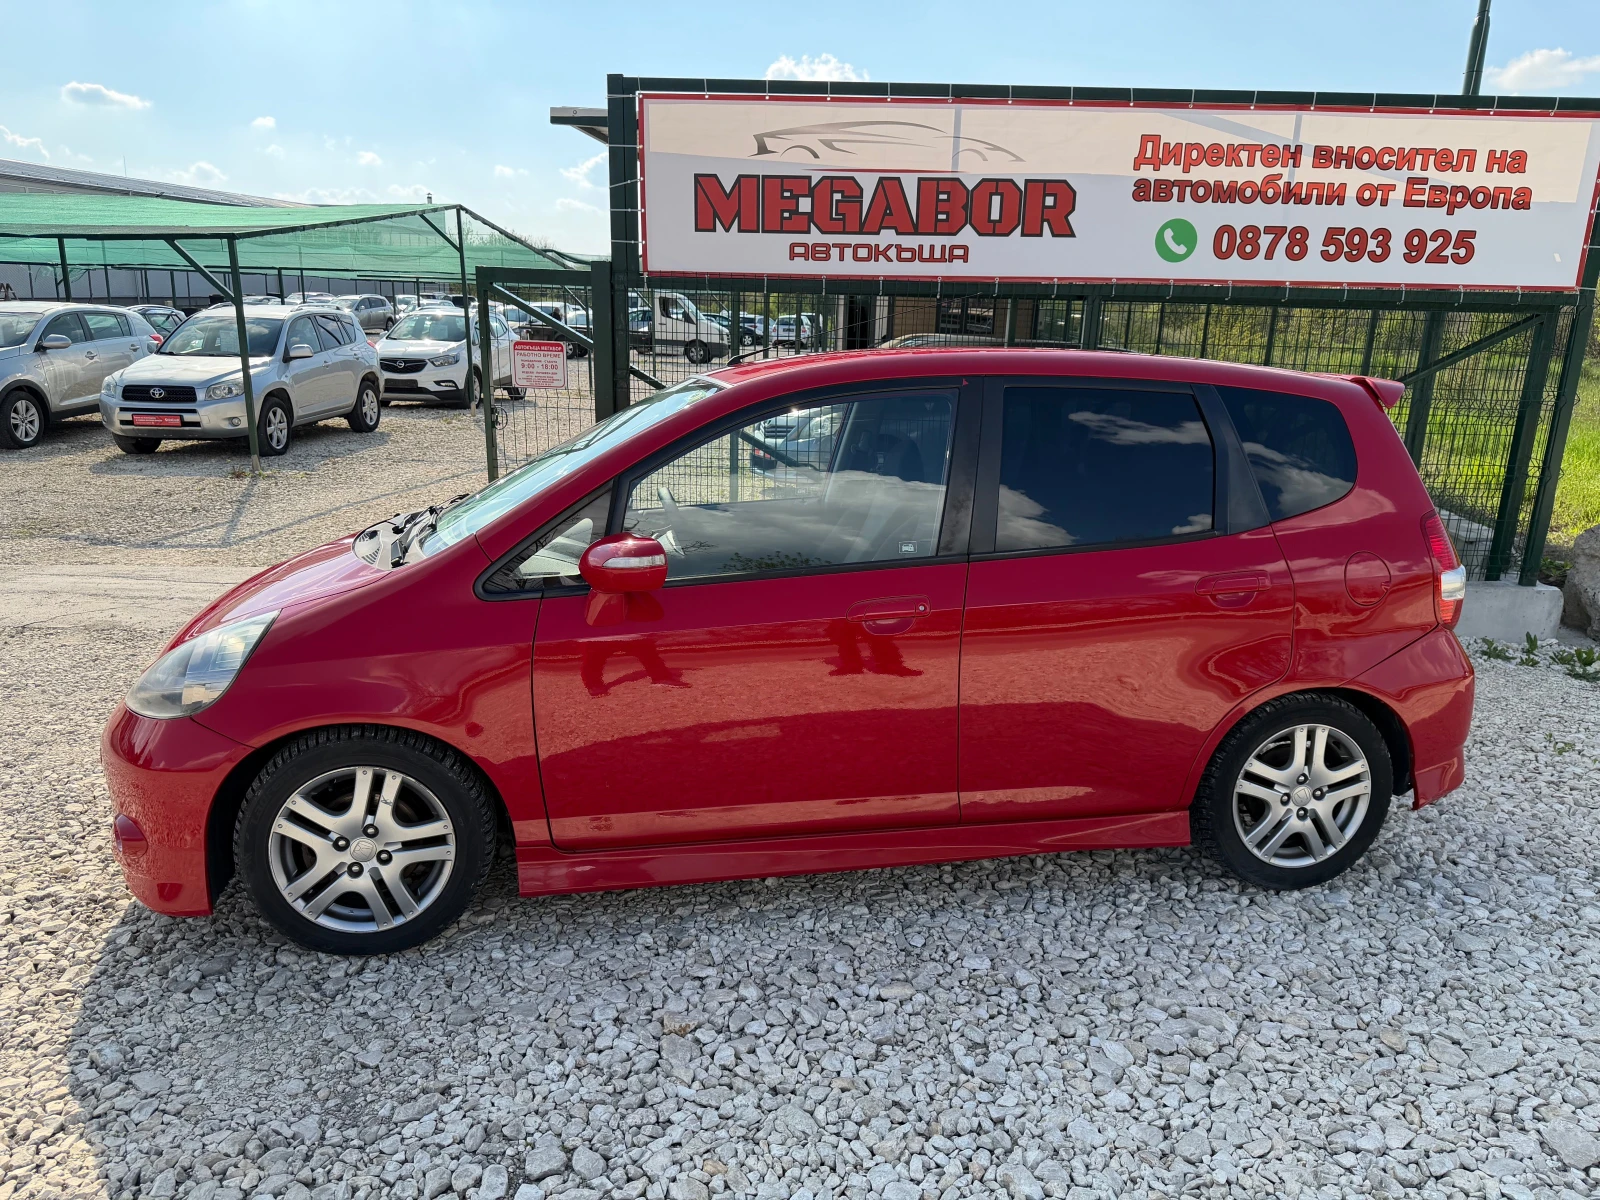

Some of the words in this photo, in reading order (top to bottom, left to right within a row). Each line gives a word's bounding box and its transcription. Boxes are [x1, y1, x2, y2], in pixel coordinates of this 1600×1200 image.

[1132, 134, 1302, 171] Директен
[1311, 144, 1477, 173] вносител
[1485, 148, 1529, 174] на
[694, 173, 1077, 238] MEGABOR
[1131, 172, 1348, 207] автомобили
[1355, 184, 1396, 207] от
[1403, 177, 1533, 216] Европа
[789, 242, 970, 264] АВТОКЪЩА
[1212, 224, 1309, 261] 0878
[1320, 227, 1392, 263] 593
[1403, 229, 1477, 264] 925
